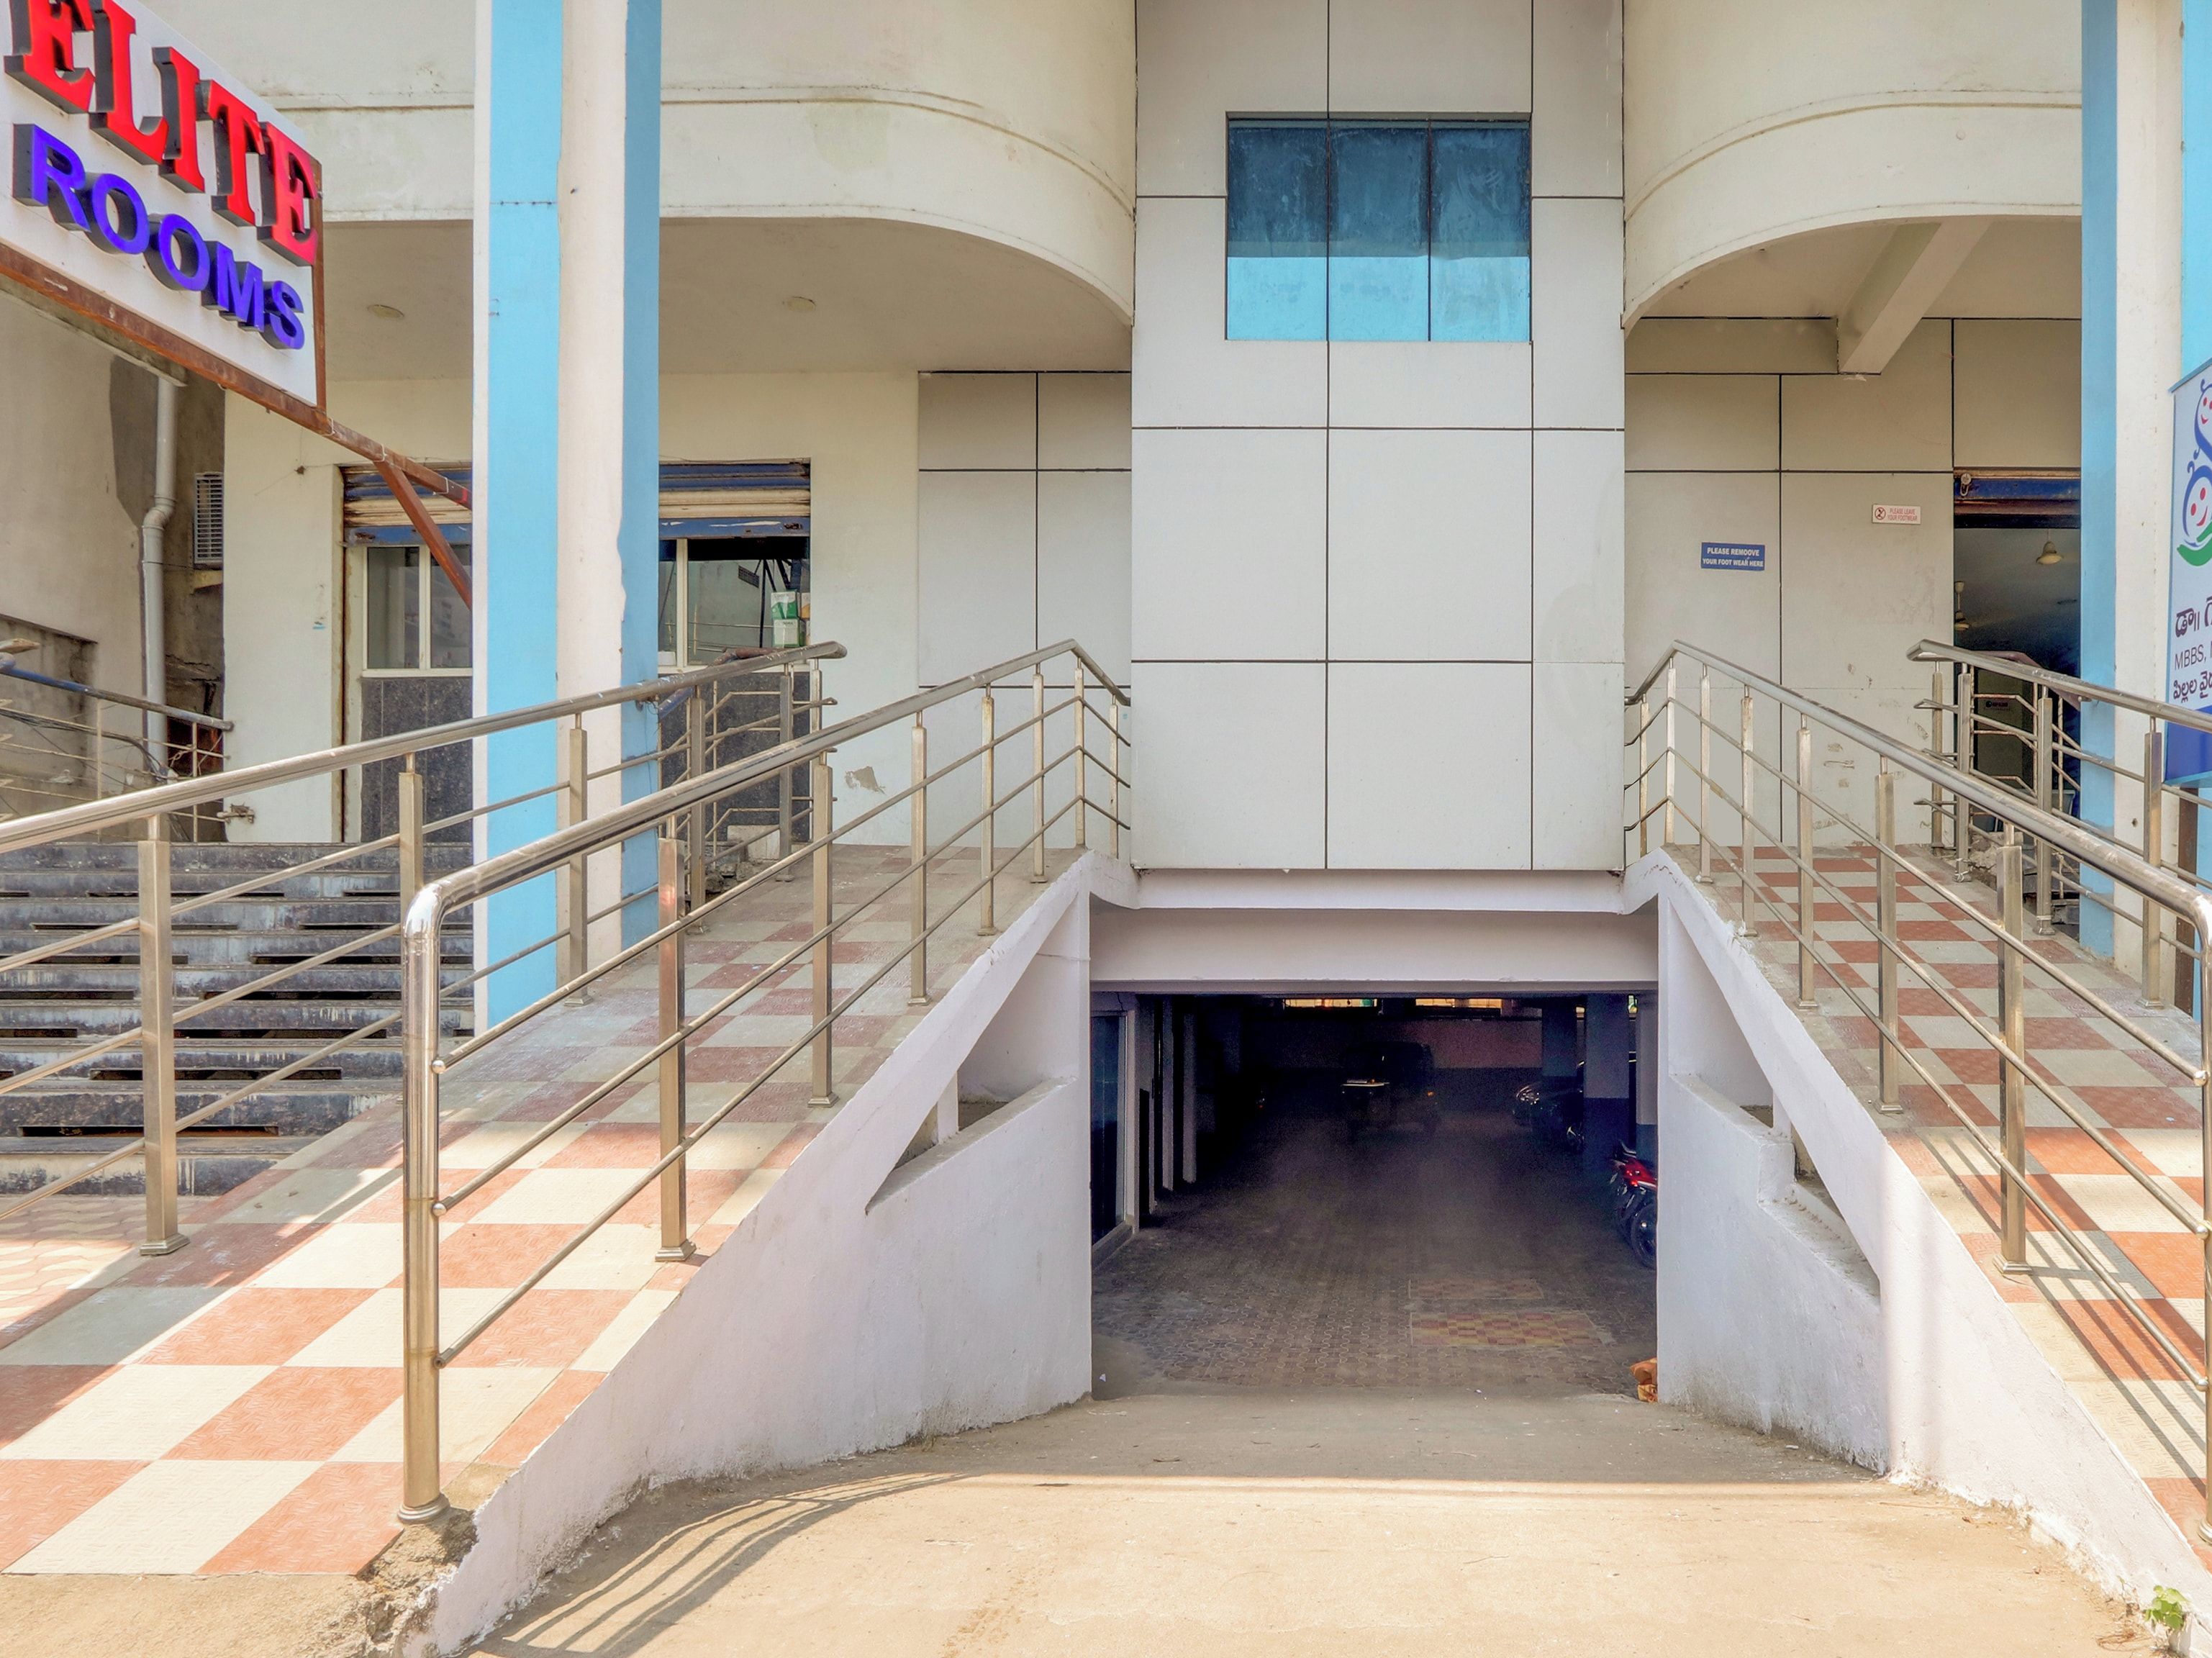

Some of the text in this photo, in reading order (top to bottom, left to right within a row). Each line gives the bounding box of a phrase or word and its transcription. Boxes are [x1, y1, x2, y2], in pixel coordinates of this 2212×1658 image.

[5, 0, 319, 266] ELITE
[12, 124, 305, 350] ROOMS
[2175, 644, 2207, 671] MBBS,
